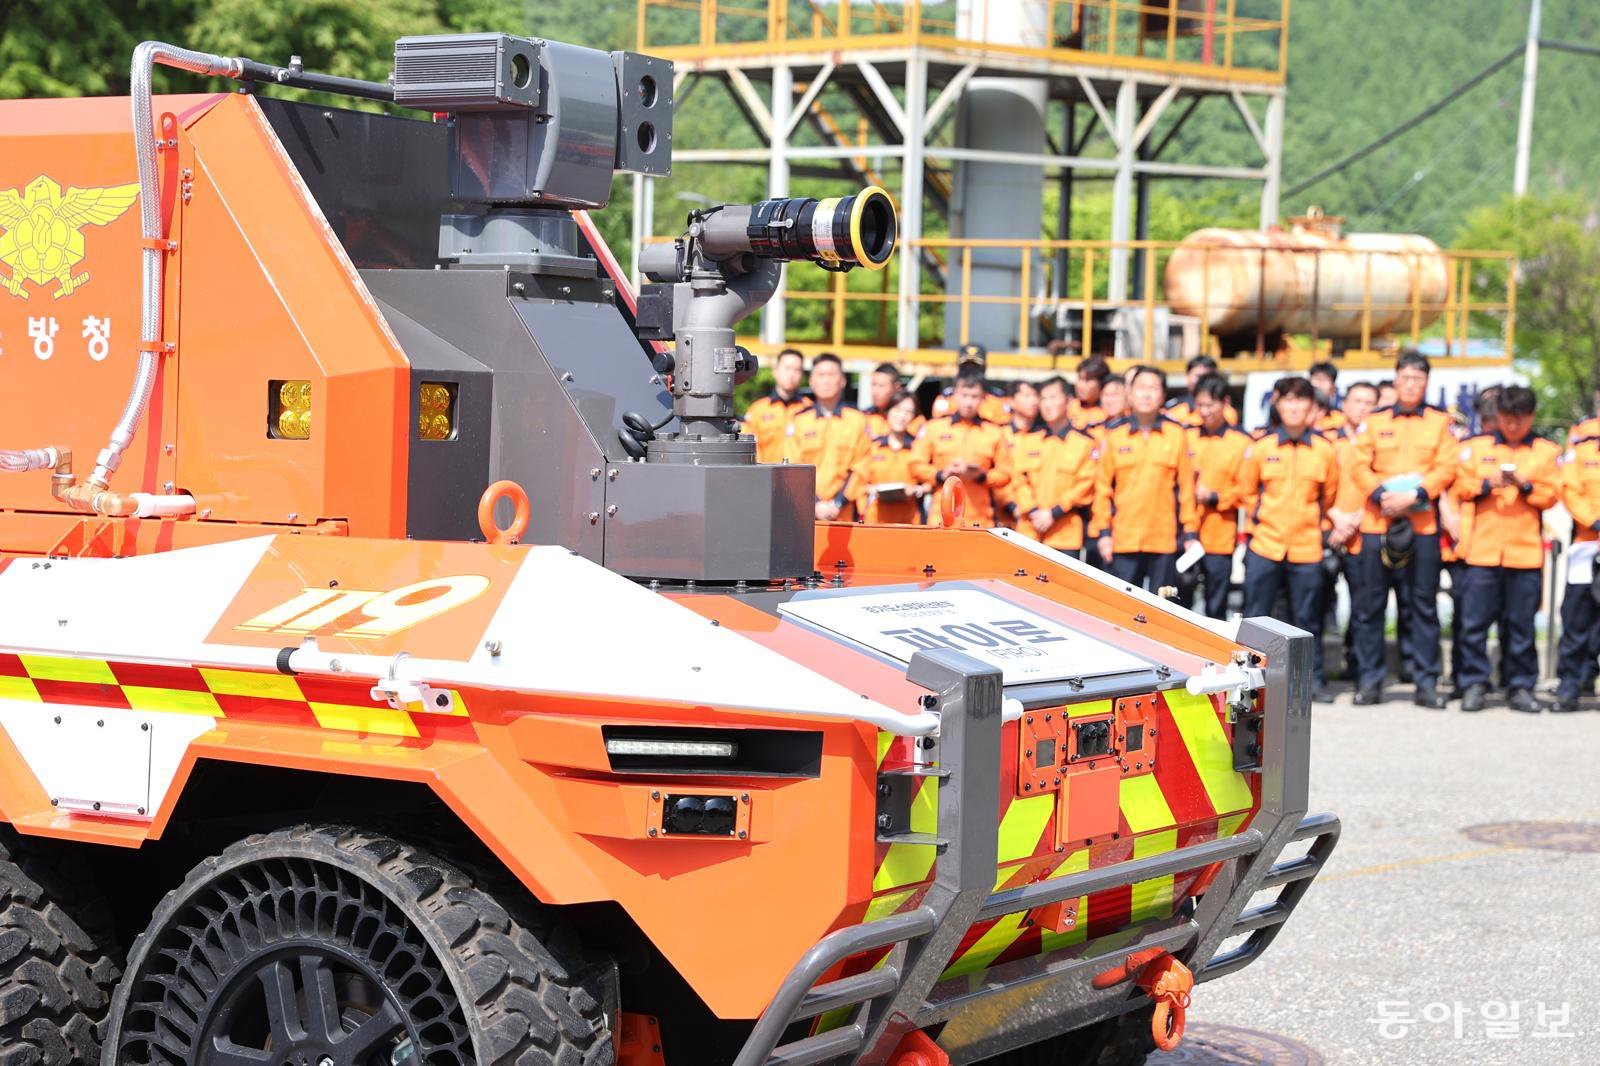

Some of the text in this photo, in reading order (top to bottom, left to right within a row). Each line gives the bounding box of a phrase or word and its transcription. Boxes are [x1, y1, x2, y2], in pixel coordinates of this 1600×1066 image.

[0, 315, 111, 361] 방청
[232, 574, 491, 640] 119
[880, 620, 1068, 651] 파이로
